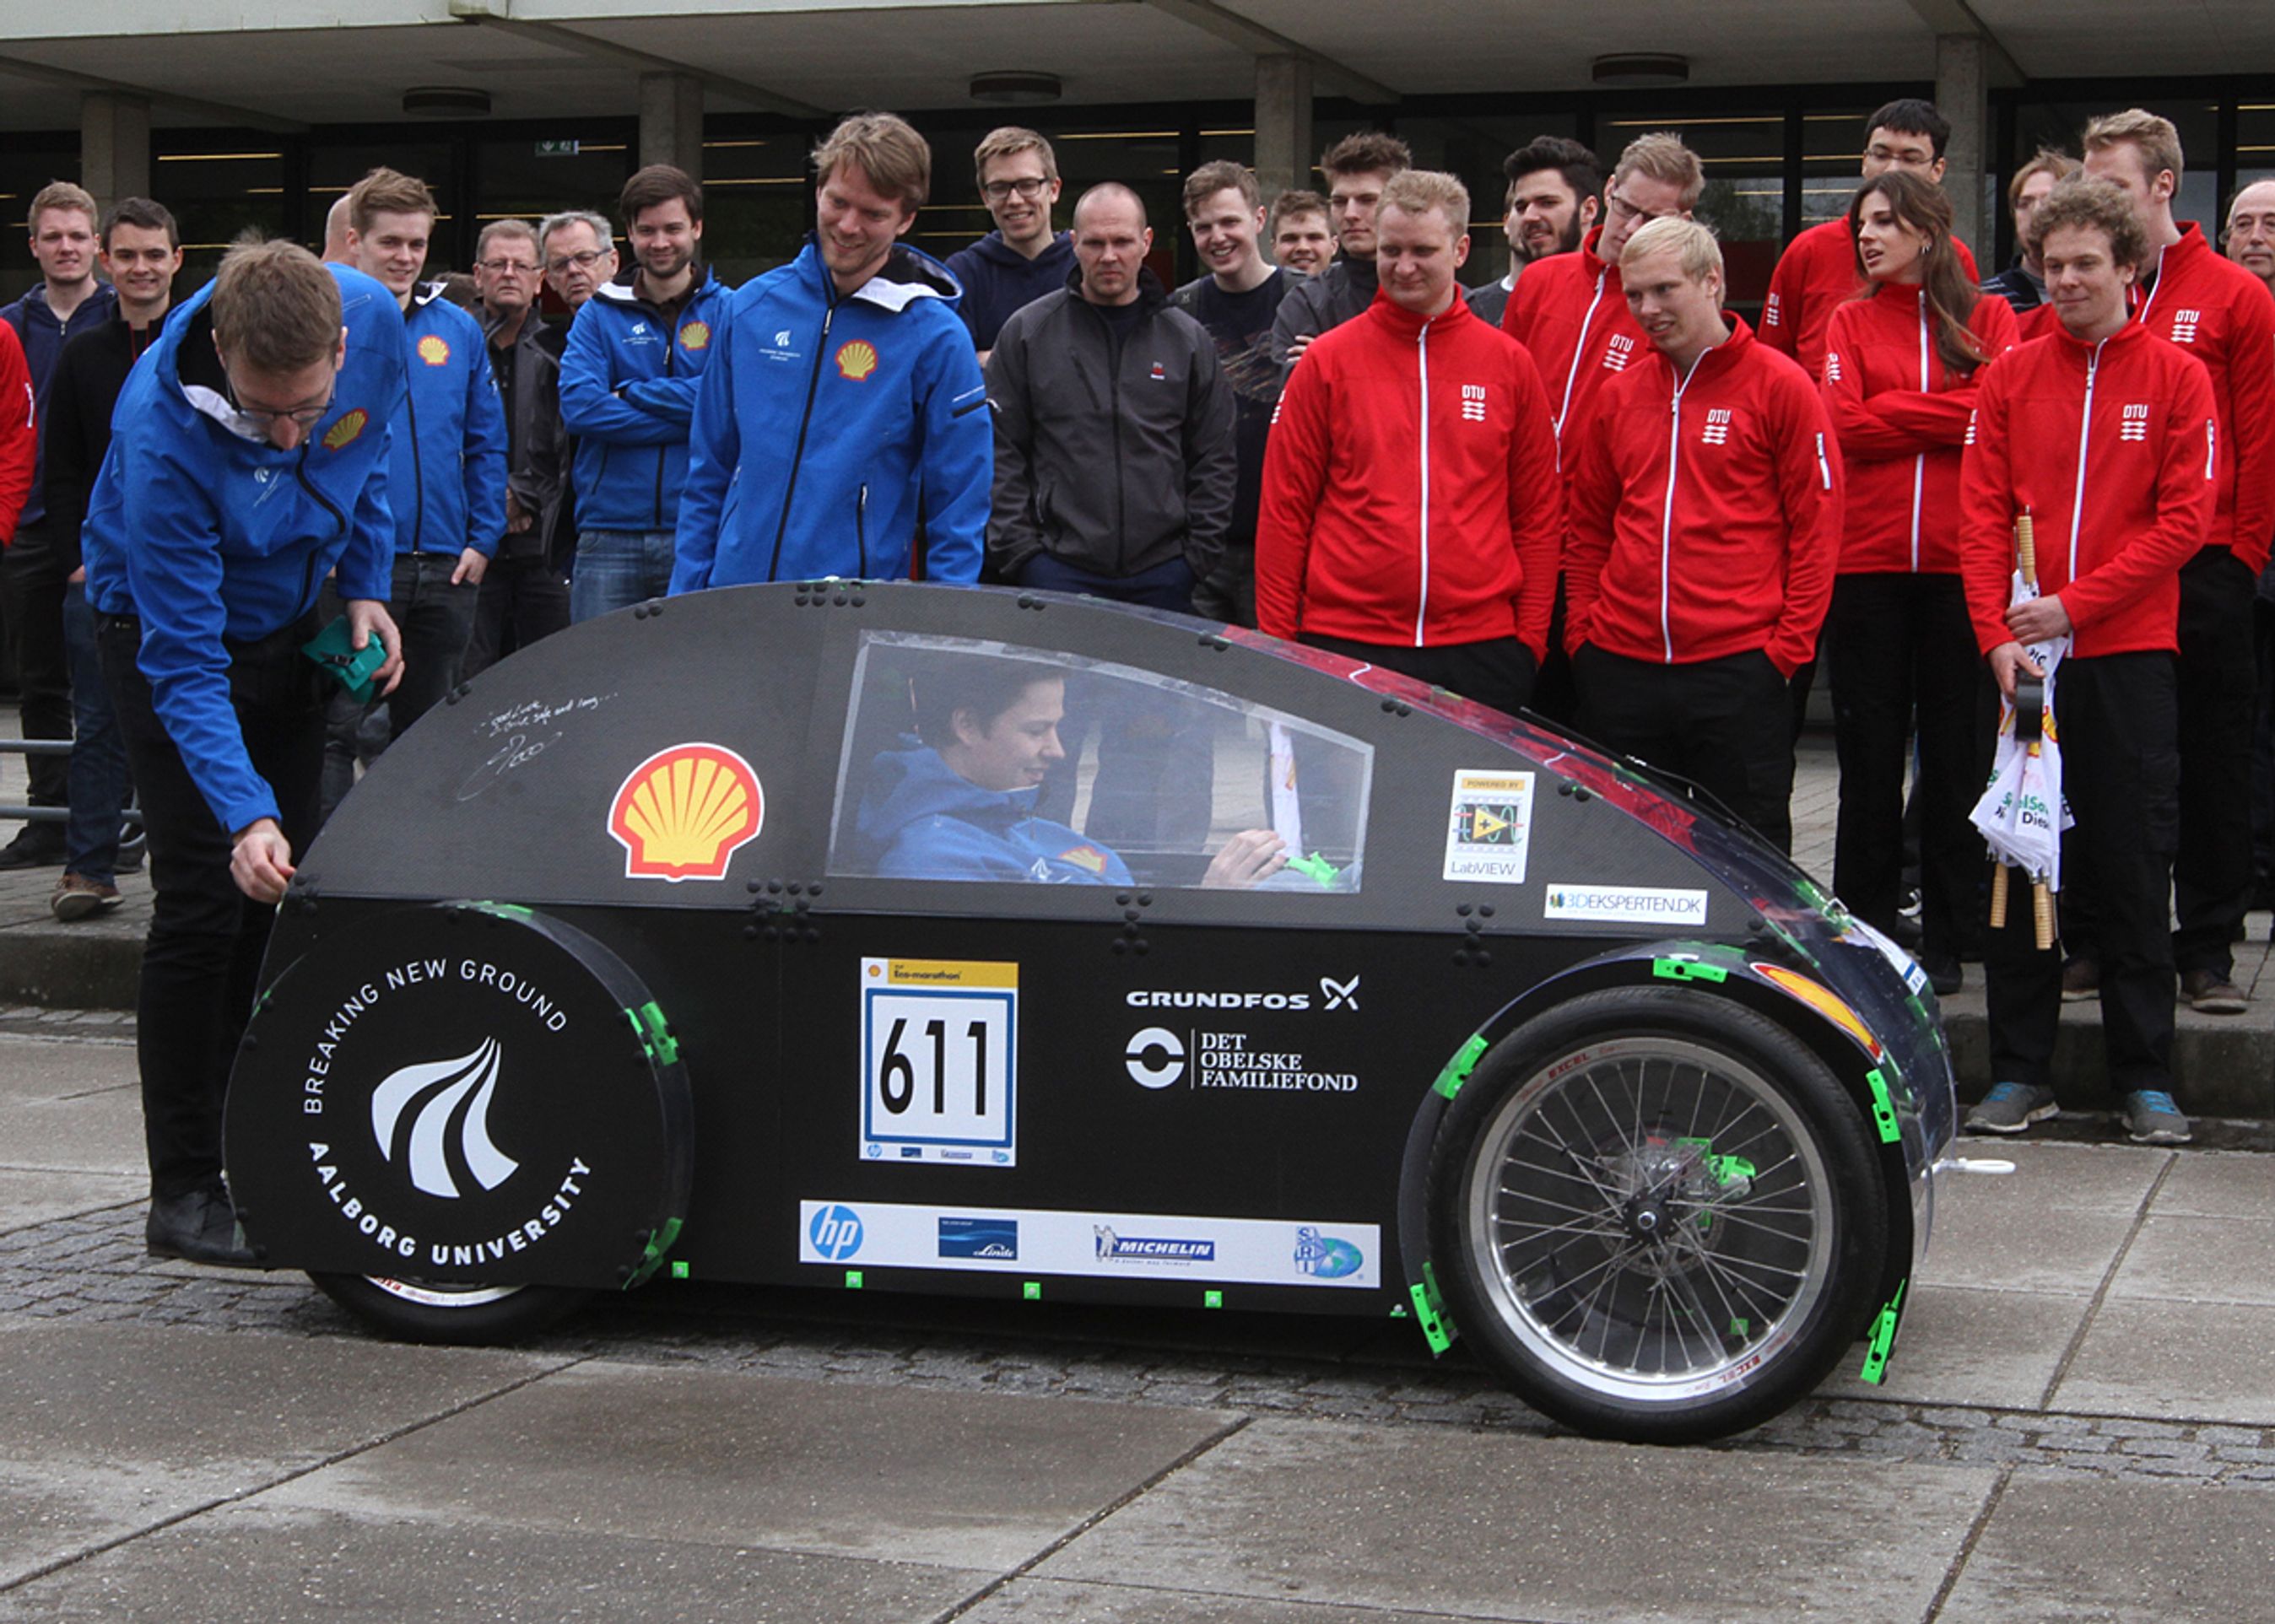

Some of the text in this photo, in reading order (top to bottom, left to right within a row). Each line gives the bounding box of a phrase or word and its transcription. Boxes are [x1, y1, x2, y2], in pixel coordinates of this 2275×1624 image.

[2174, 310, 2200, 323] DTU
[1609, 333, 1635, 352] DTU
[1462, 384, 1485, 401] DTU
[1706, 409, 1731, 424] DTU
[2123, 404, 2148, 418] DTU
[1467, 780, 1506, 789] POWERED
[1451, 861, 1516, 876] LabVIEW
[1566, 893, 1702, 914] 3DEKSPERTEN.DK
[1126, 991, 1310, 1010] GRUNDFOS
[304, 958, 567, 1114] BREAKING NEW GROUND
[1201, 1033, 1247, 1050] DET
[880, 1017, 987, 1116] 611
[1201, 1052, 1302, 1071] OBELSKE
[1201, 1071, 1359, 1092] FAMILIEFOND
[309, 1142, 591, 1265] AALBORG UNIVERSITY
[815, 1206, 858, 1259] hp
[1119, 1240, 1211, 1256] MICHELIN
